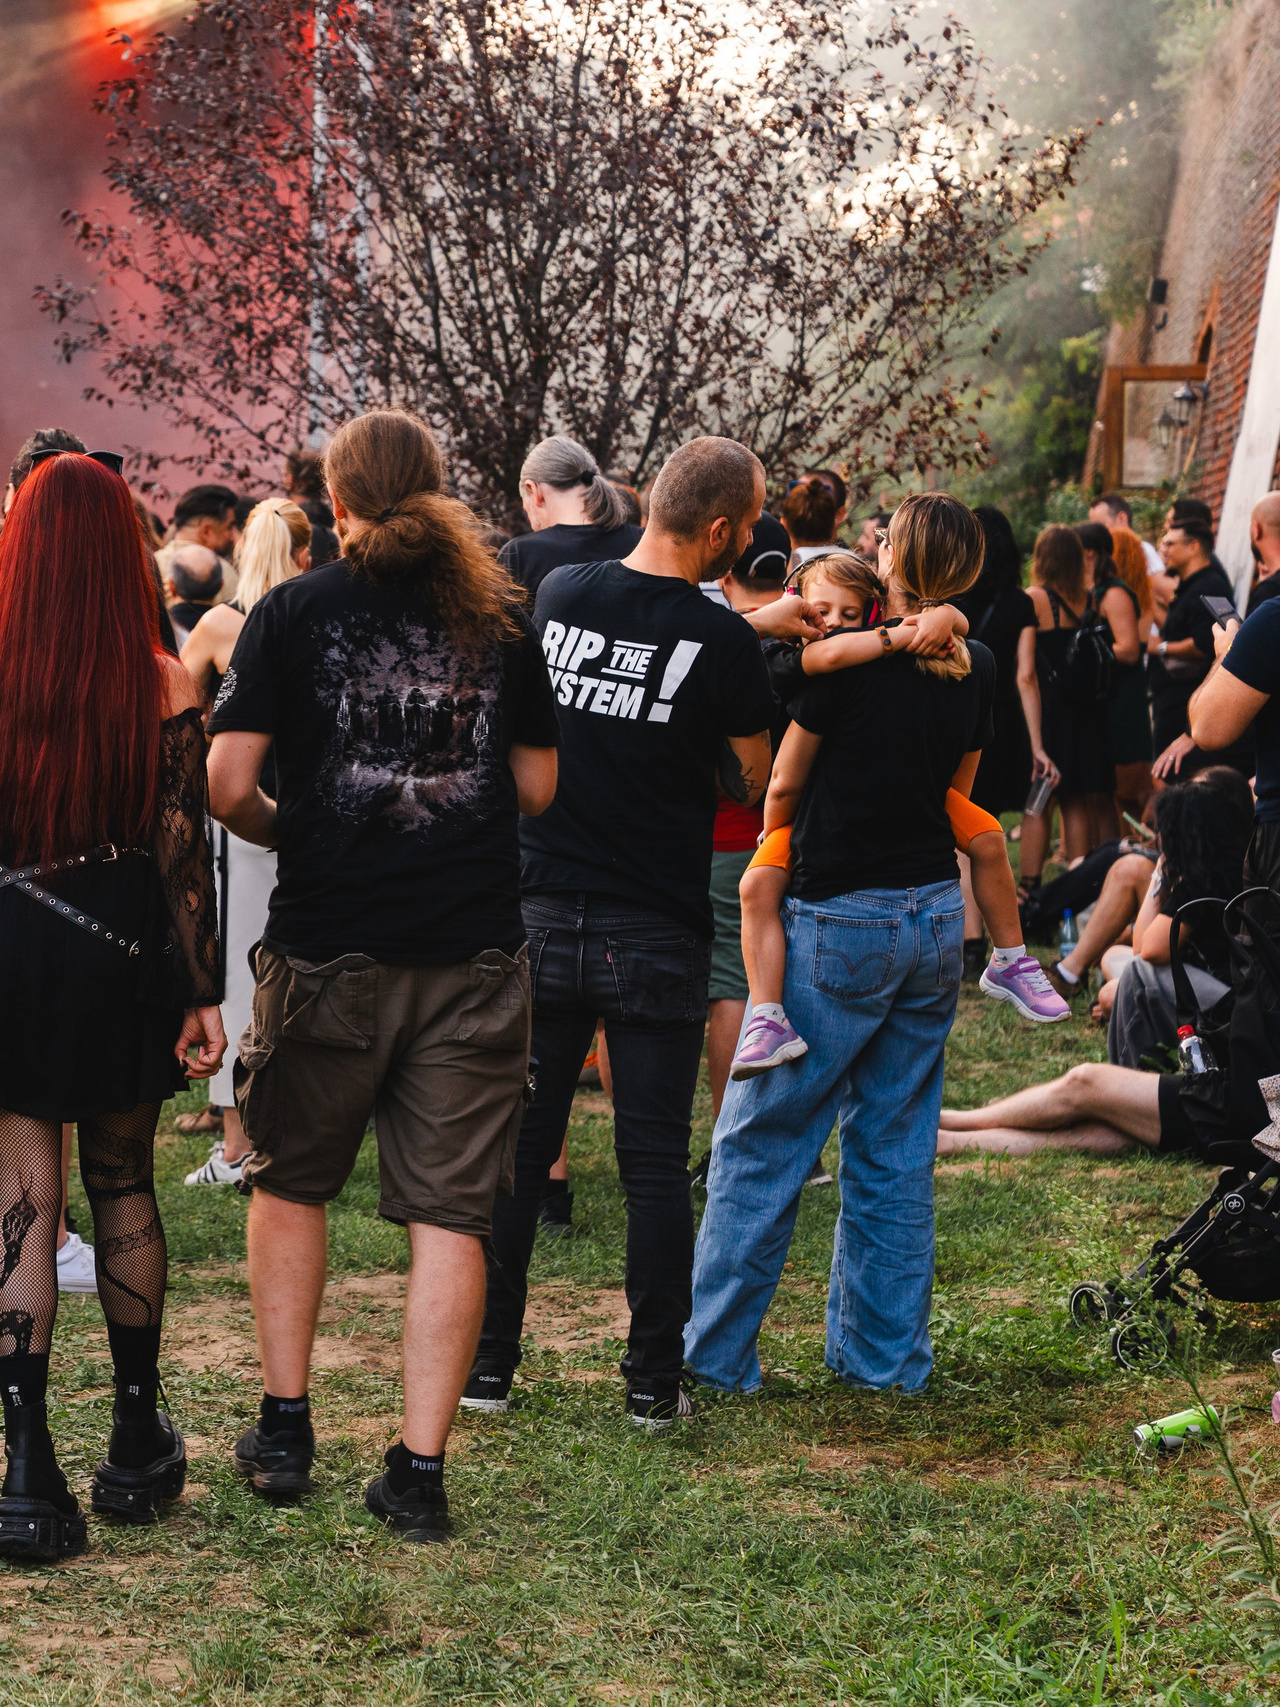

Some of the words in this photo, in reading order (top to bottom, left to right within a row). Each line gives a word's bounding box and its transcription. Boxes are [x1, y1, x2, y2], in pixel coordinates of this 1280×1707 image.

[542, 619, 606, 673] RIP
[609, 646, 654, 674] THE
[547, 667, 646, 720] YSTEM
[1228, 1198, 1241, 1210] gb
[478, 1375, 502, 1383] adidas
[631, 1393, 655, 1401] adidas
[279, 1403, 305, 1413] PUM
